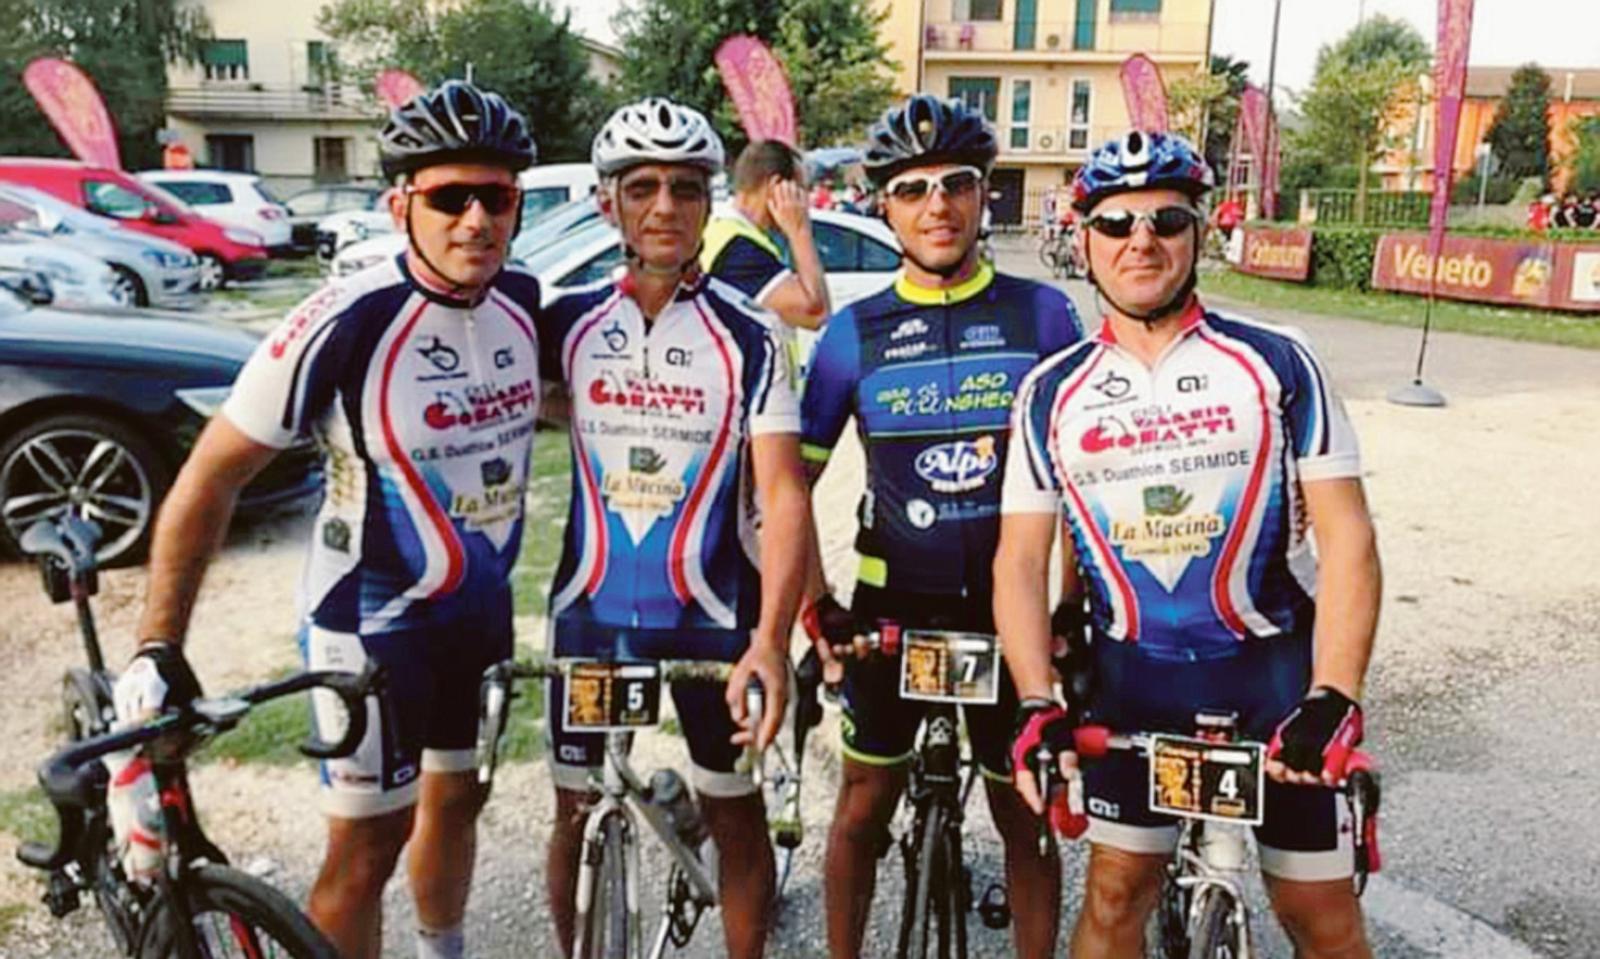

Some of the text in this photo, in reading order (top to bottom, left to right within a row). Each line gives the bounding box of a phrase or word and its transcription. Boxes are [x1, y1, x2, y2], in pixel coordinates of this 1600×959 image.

[1394, 244, 1493, 288] Veneto
[1169, 450, 1250, 473] SERMIDE
[1113, 513, 1220, 541] La Macina
[962, 655, 977, 683] 7
[627, 682, 643, 711] 5
[1218, 769, 1238, 800] 4
